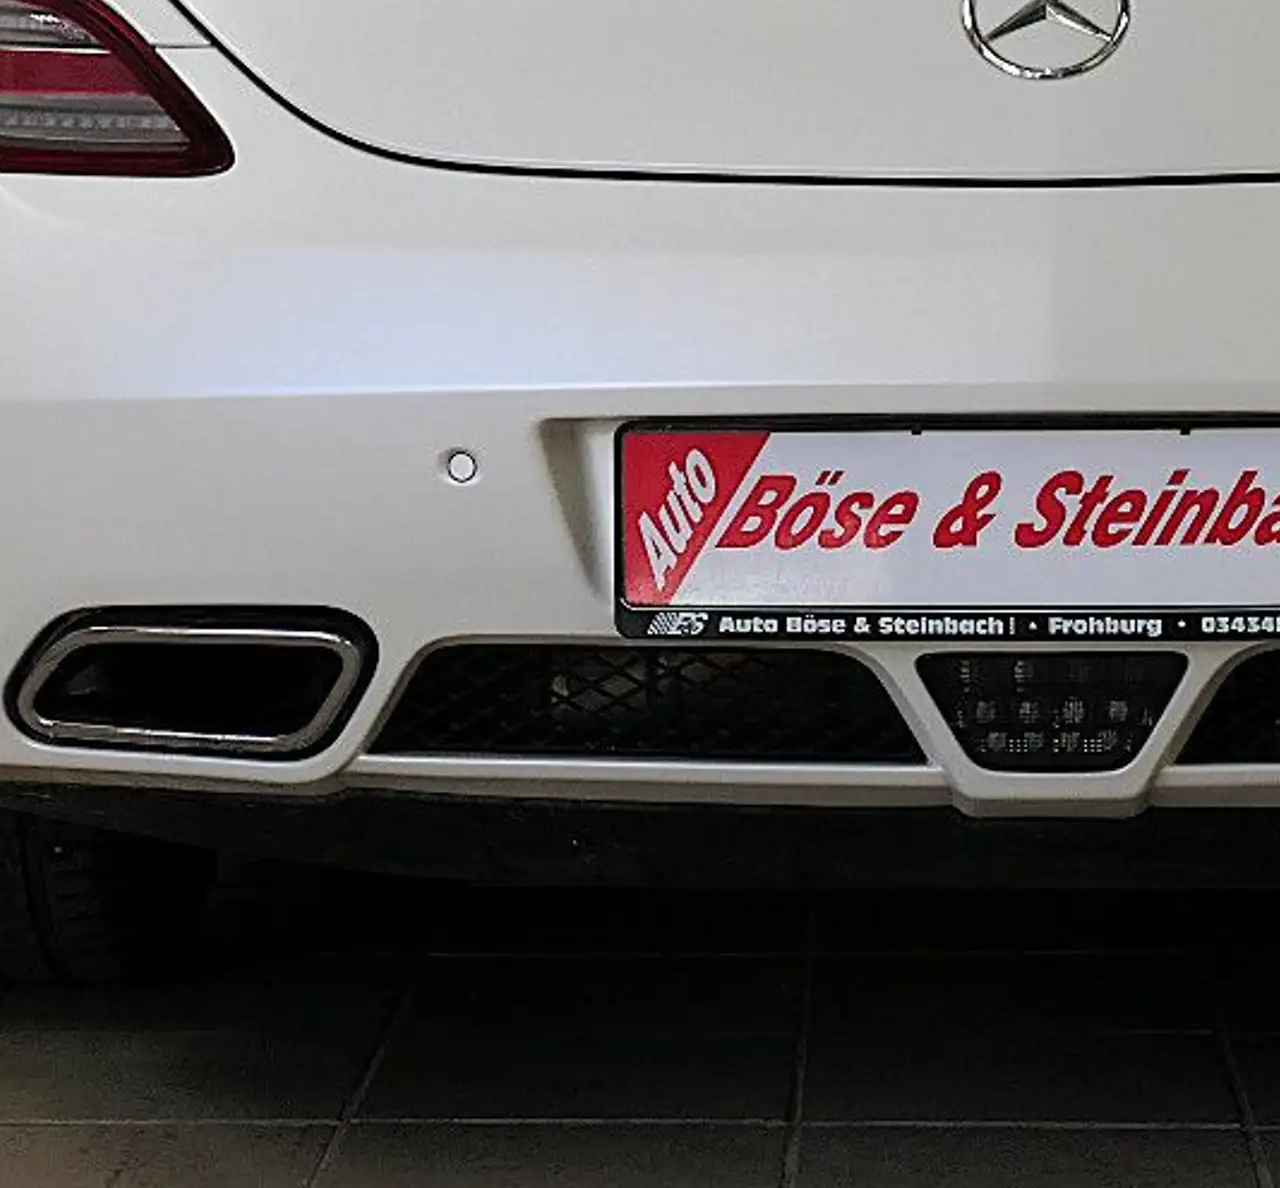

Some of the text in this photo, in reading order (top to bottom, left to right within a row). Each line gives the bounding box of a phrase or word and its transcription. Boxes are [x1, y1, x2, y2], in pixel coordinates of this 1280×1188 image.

[637, 447, 717, 591] Auto
[715, 470, 921, 550] Böse
[932, 470, 1003, 549] &
[719, 616, 779, 634] Auto
[785, 613, 846, 634] Böse
[853, 616, 871, 634] &
[878, 615, 1004, 635] Steinbach
[1047, 615, 1163, 638] Frohburg
